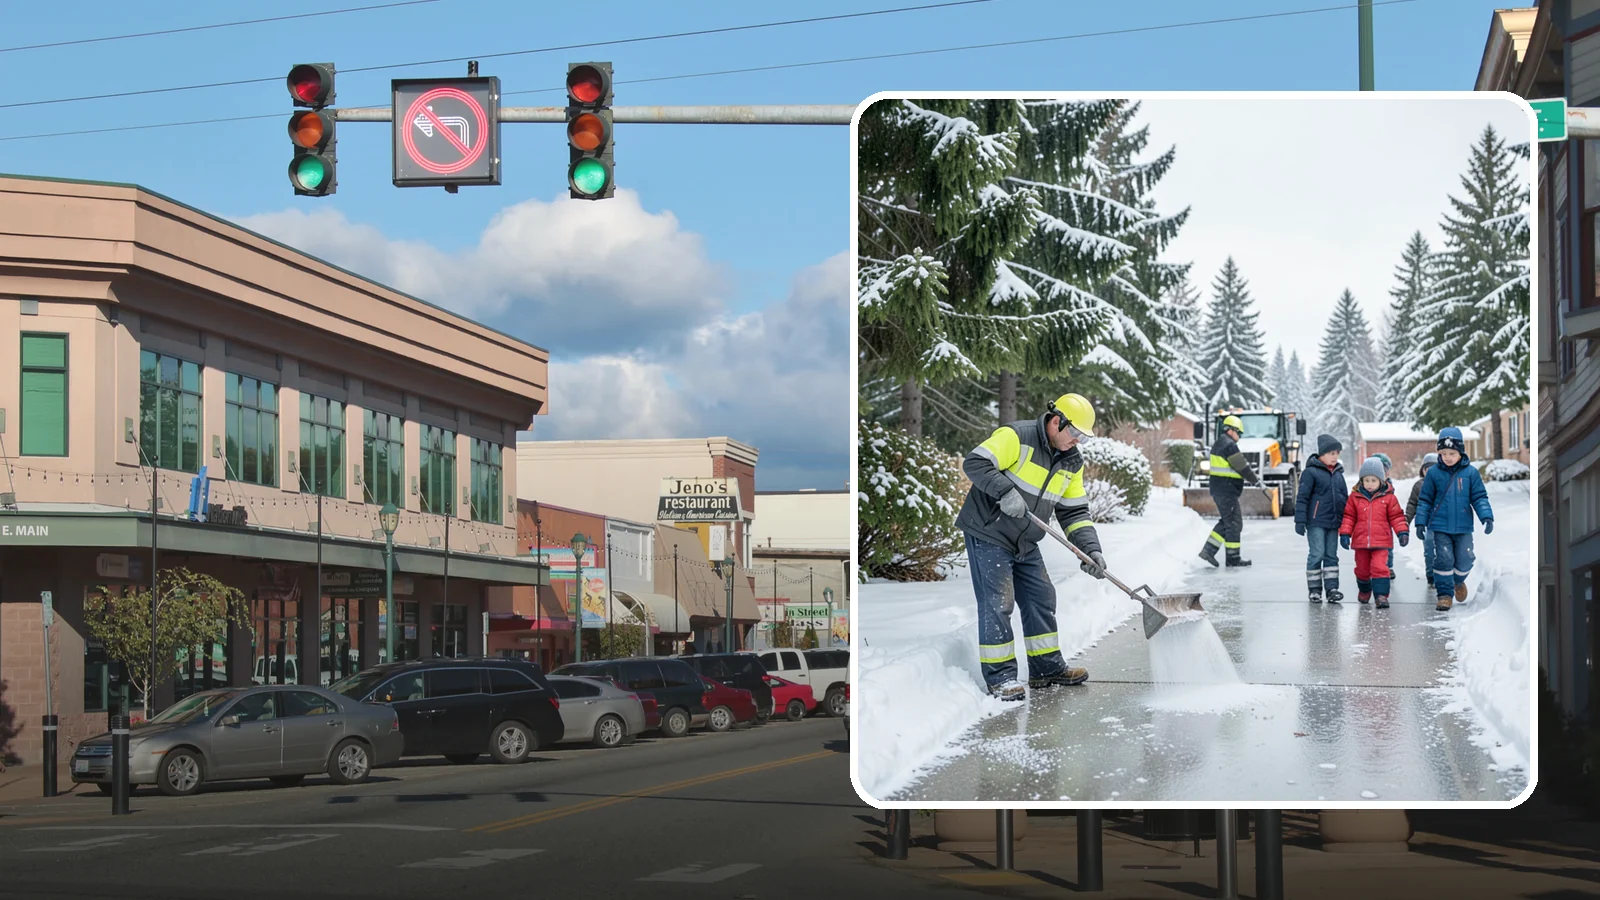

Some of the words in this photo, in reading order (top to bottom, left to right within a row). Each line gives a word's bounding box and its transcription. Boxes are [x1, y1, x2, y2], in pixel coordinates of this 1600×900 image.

[669, 480, 728, 495] Jeno's
[665, 496, 731, 509] restaurant
[658, 509, 682, 519] Italian
[686, 509, 715, 519] American
[715, 509, 738, 519] Cuisine
[2, 525, 13, 536] E.
[15, 525, 49, 536] MAIN
